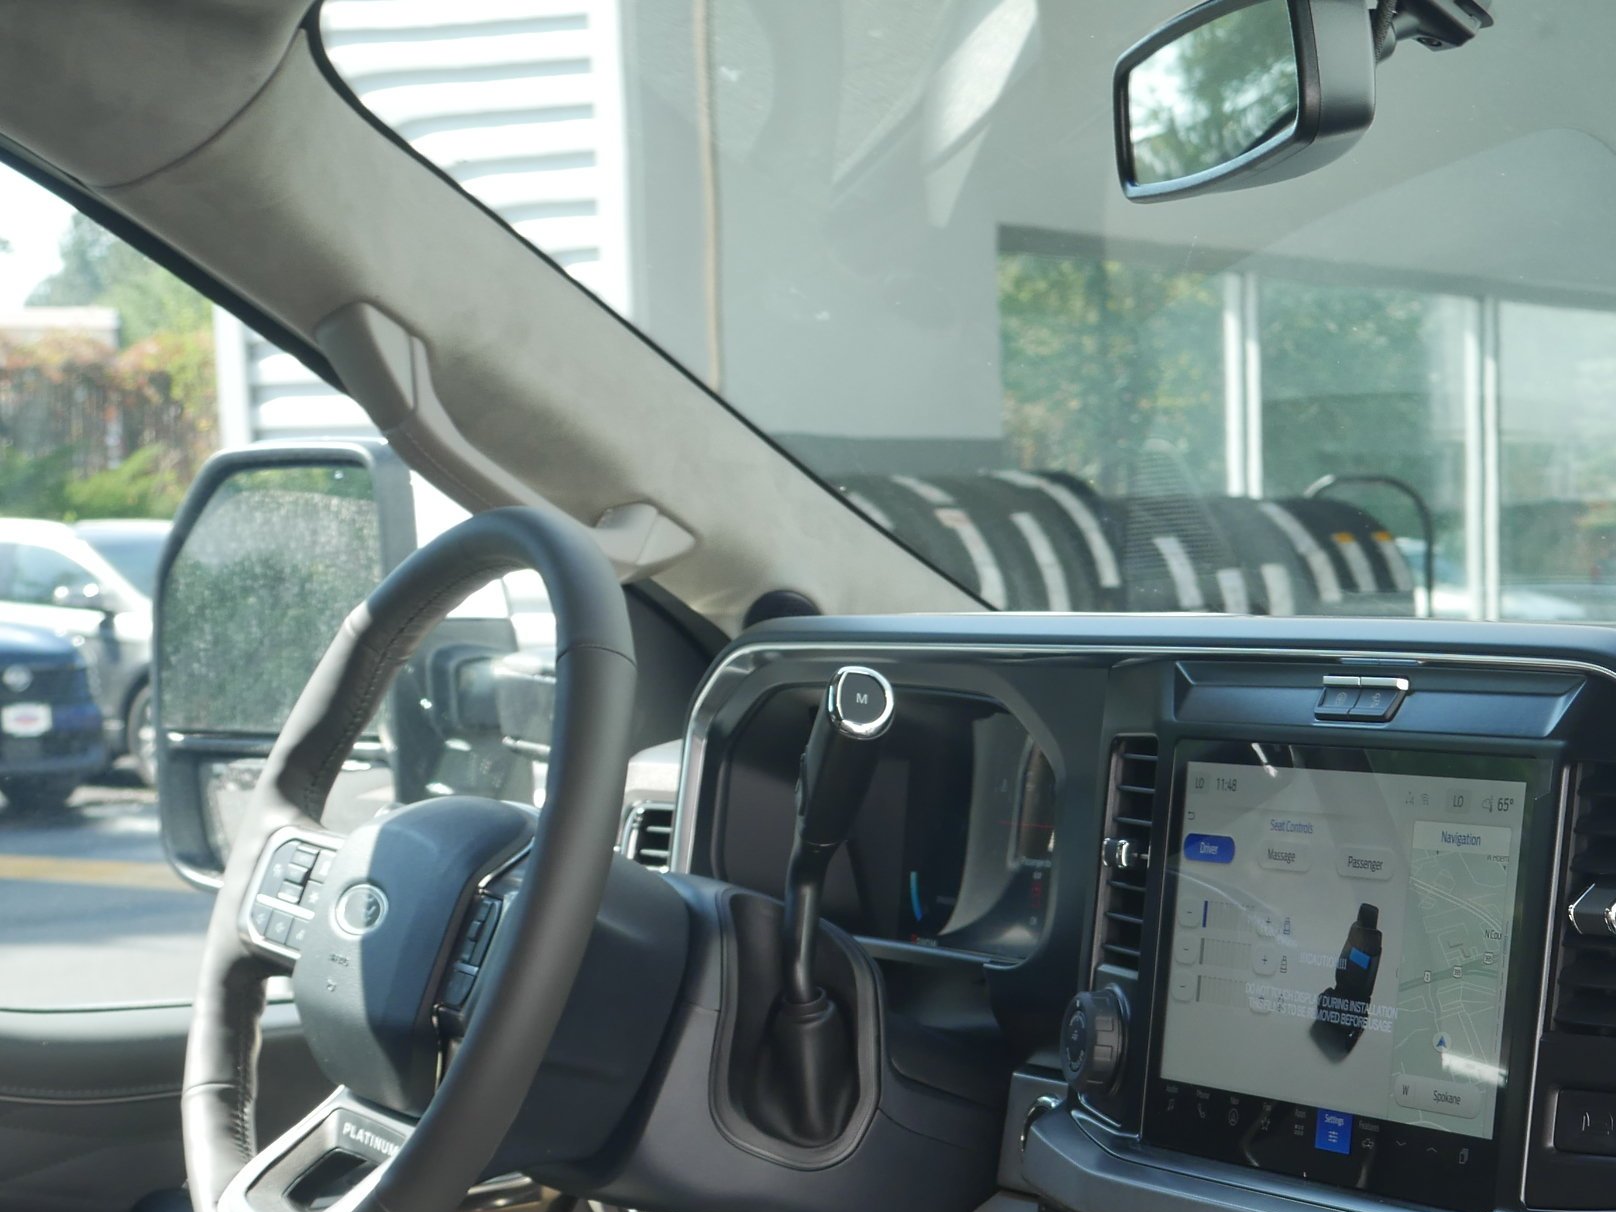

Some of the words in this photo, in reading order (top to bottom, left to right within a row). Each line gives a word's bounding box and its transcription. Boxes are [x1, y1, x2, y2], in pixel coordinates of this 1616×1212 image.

[856, 692, 868, 705] M
[1216, 777, 1237, 792] 11:48
[1453, 793, 1464, 807] LO
[1270, 818, 1285, 831] Seat
[1286, 820, 1313, 834] Controls
[1441, 830, 1481, 847] Navigation
[1200, 841, 1219, 855] Driver
[1268, 847, 1296, 864] Massage
[1347, 855, 1383, 873] Passenger
[1322, 995, 1348, 1011] DURING
[1350, 1000, 1398, 1019] INSTALLATION
[1341, 1012, 1367, 1029] BEFORE
[1368, 1017, 1393, 1033] USAGE
[1402, 1083, 1410, 1095] W
[1433, 1089, 1461, 1105] Spokane
[1324, 1113, 1345, 1128] Settings
[342, 1121, 400, 1158] PLATINUM
